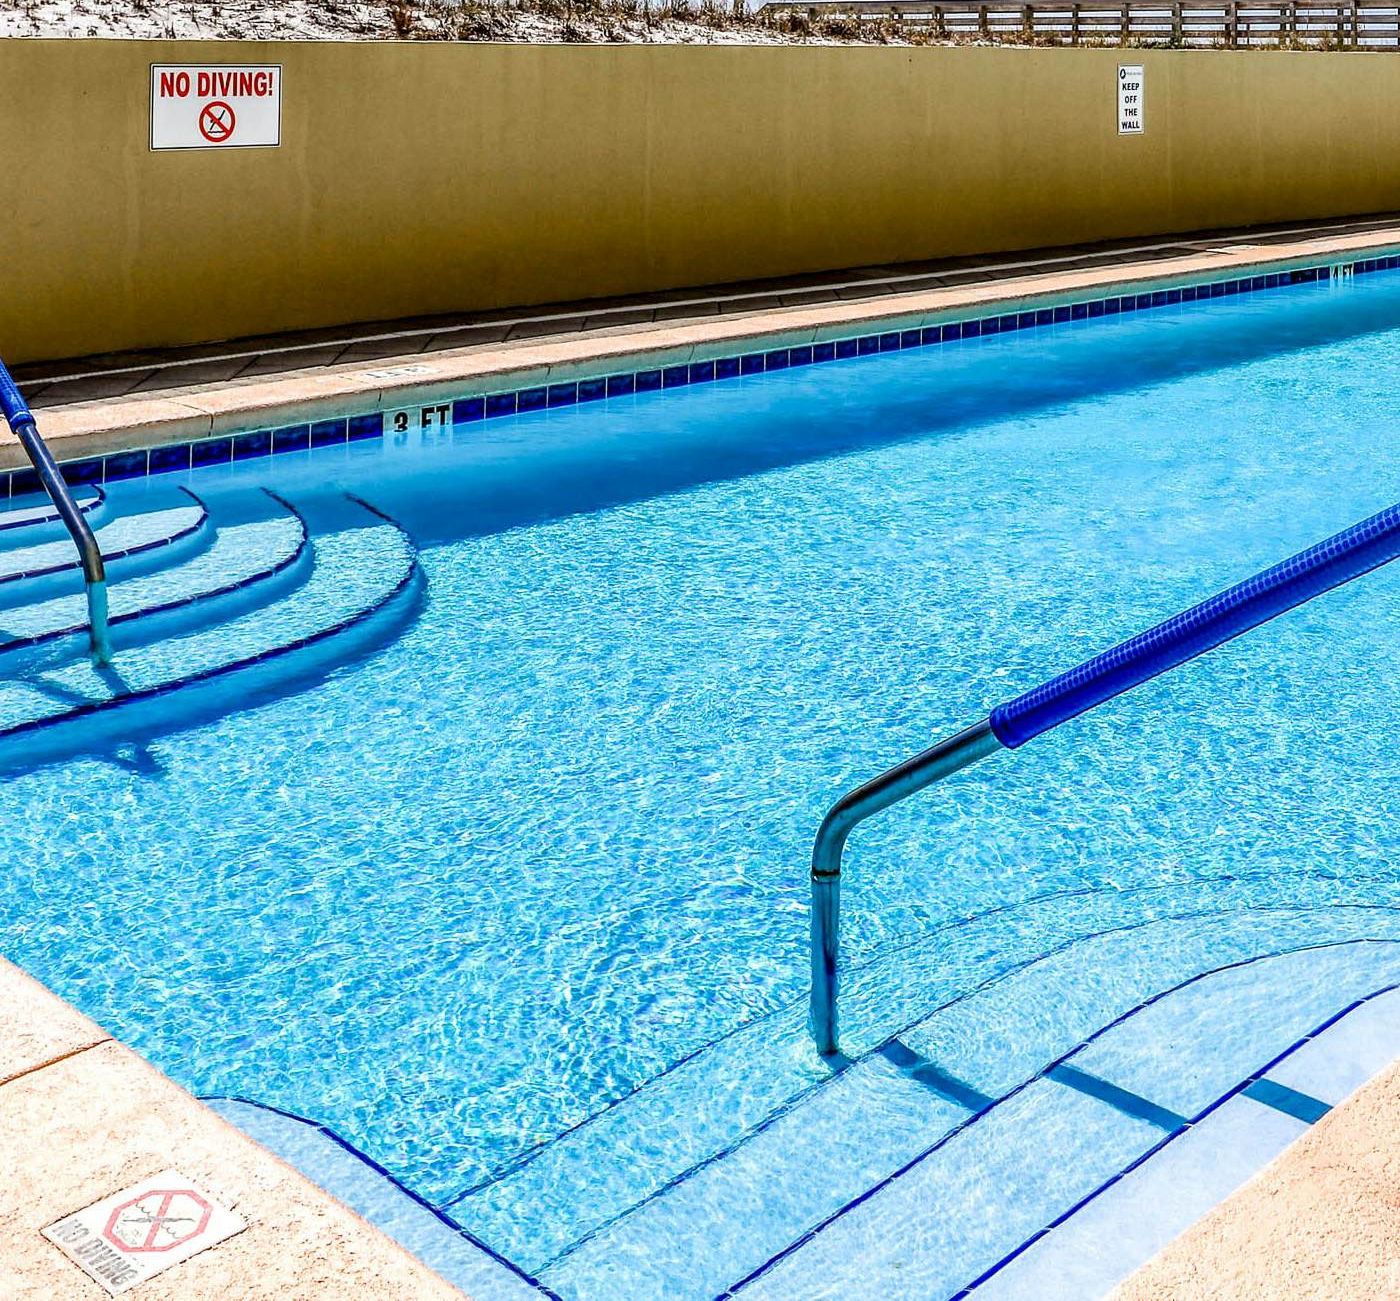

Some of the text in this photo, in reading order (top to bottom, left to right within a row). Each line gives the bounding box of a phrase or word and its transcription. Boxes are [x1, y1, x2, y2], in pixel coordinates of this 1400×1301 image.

[160, 72, 273, 97] NO DIVING!
[1122, 83, 1140, 91] KEEP
[1124, 95, 1138, 104] OFF
[1124, 108, 1138, 117] THE
[1121, 121, 1140, 129] WALL
[394, 404, 450, 433] 3 FT
[52, 1219, 139, 1287] NO DIVING
